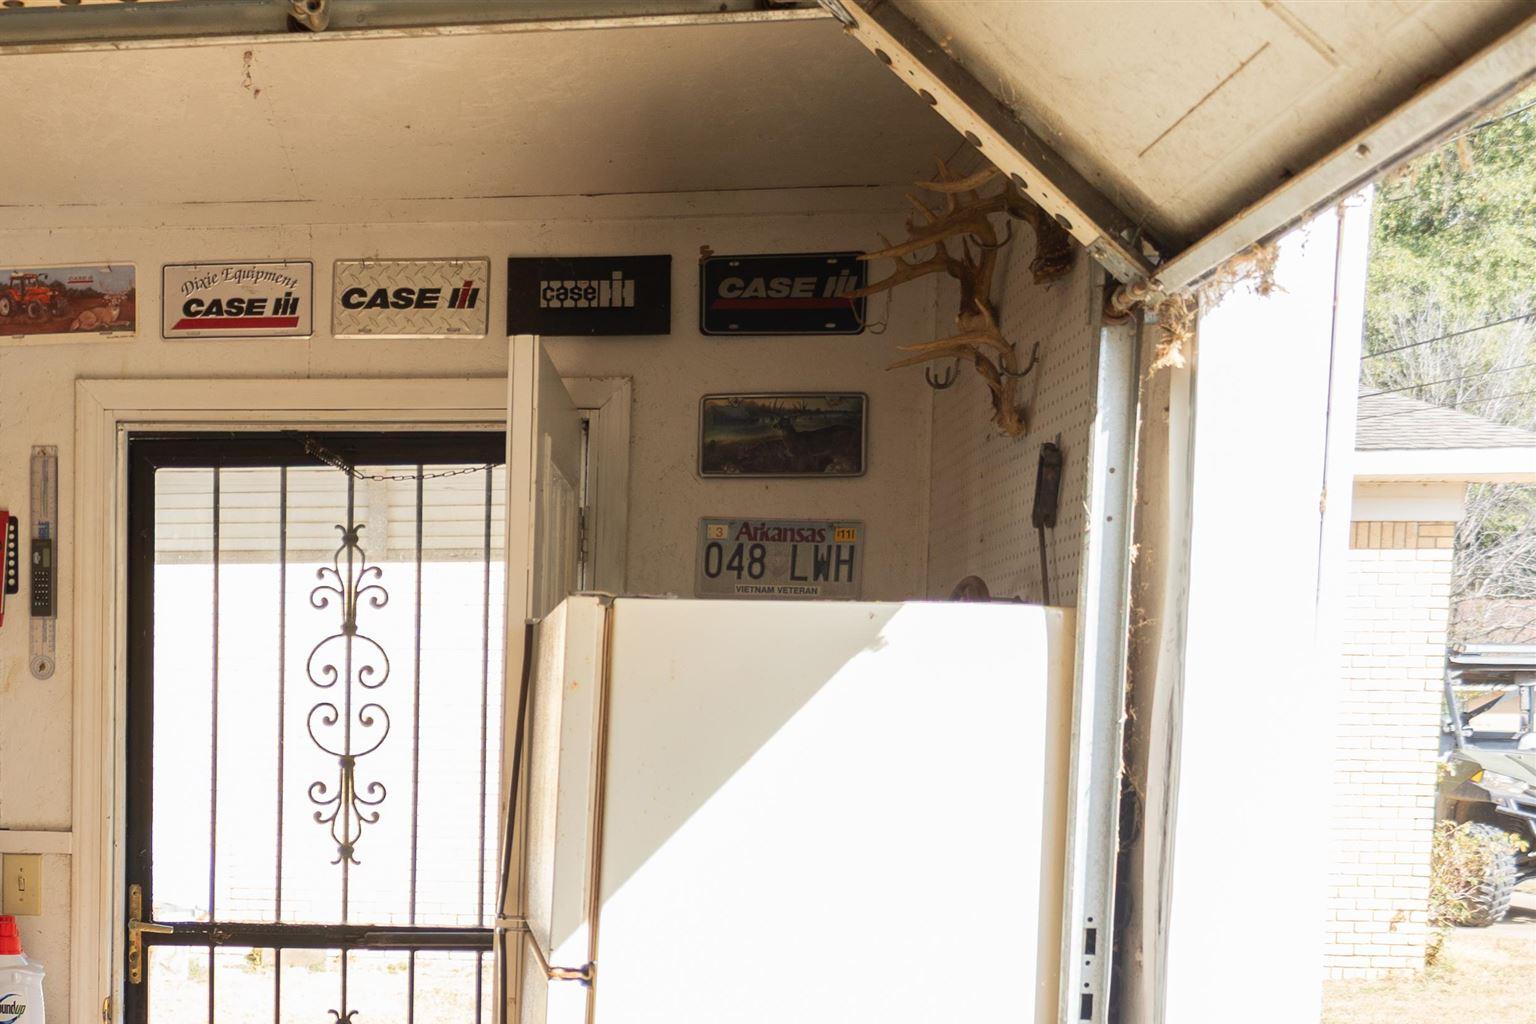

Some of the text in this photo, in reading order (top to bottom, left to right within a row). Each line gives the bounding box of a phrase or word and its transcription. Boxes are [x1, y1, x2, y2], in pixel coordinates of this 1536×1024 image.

[181, 265, 299, 297] Dixie Equipment
[718, 276, 818, 299] CASE
[340, 286, 443, 310] CASE
[541, 280, 598, 306] case
[182, 297, 268, 318] CASE
[715, 527, 724, 538] 3
[735, 520, 827, 543] Arkansas
[703, 541, 856, 583] 048 LWH
[735, 584, 818, 595] VIETNAM VETERAN
